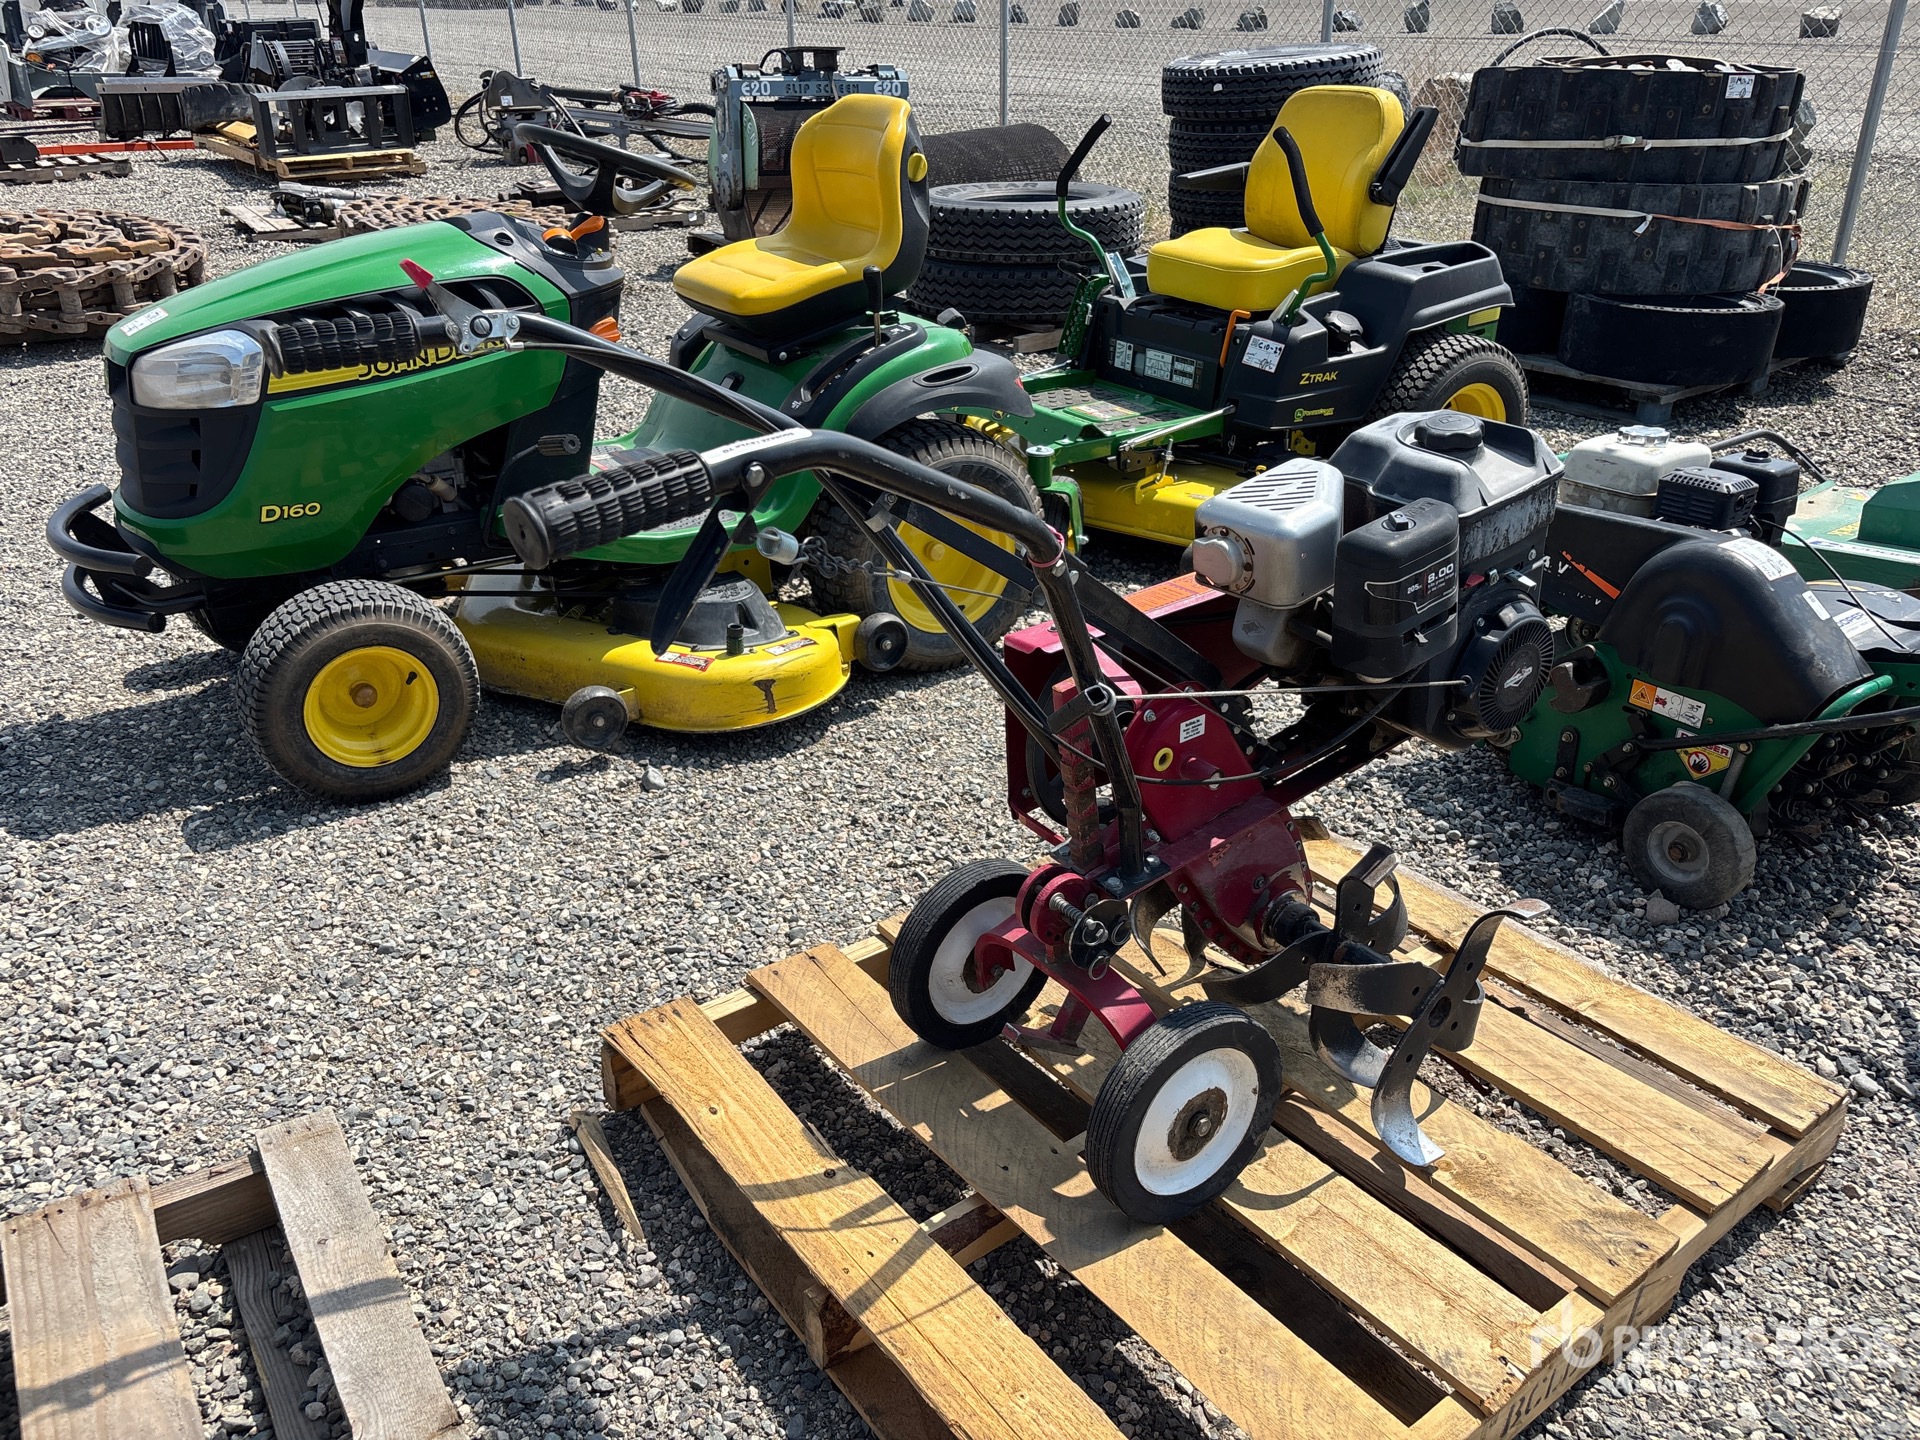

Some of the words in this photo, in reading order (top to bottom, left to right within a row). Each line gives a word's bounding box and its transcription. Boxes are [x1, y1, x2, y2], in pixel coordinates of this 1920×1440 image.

[741, 81, 771, 96] E20
[784, 83, 810, 95] FLIP
[873, 80, 902, 95] E20
[1299, 371, 1339, 385] ZTRAK
[260, 502, 321, 523] D160
[1427, 563, 1454, 584] 8.00
